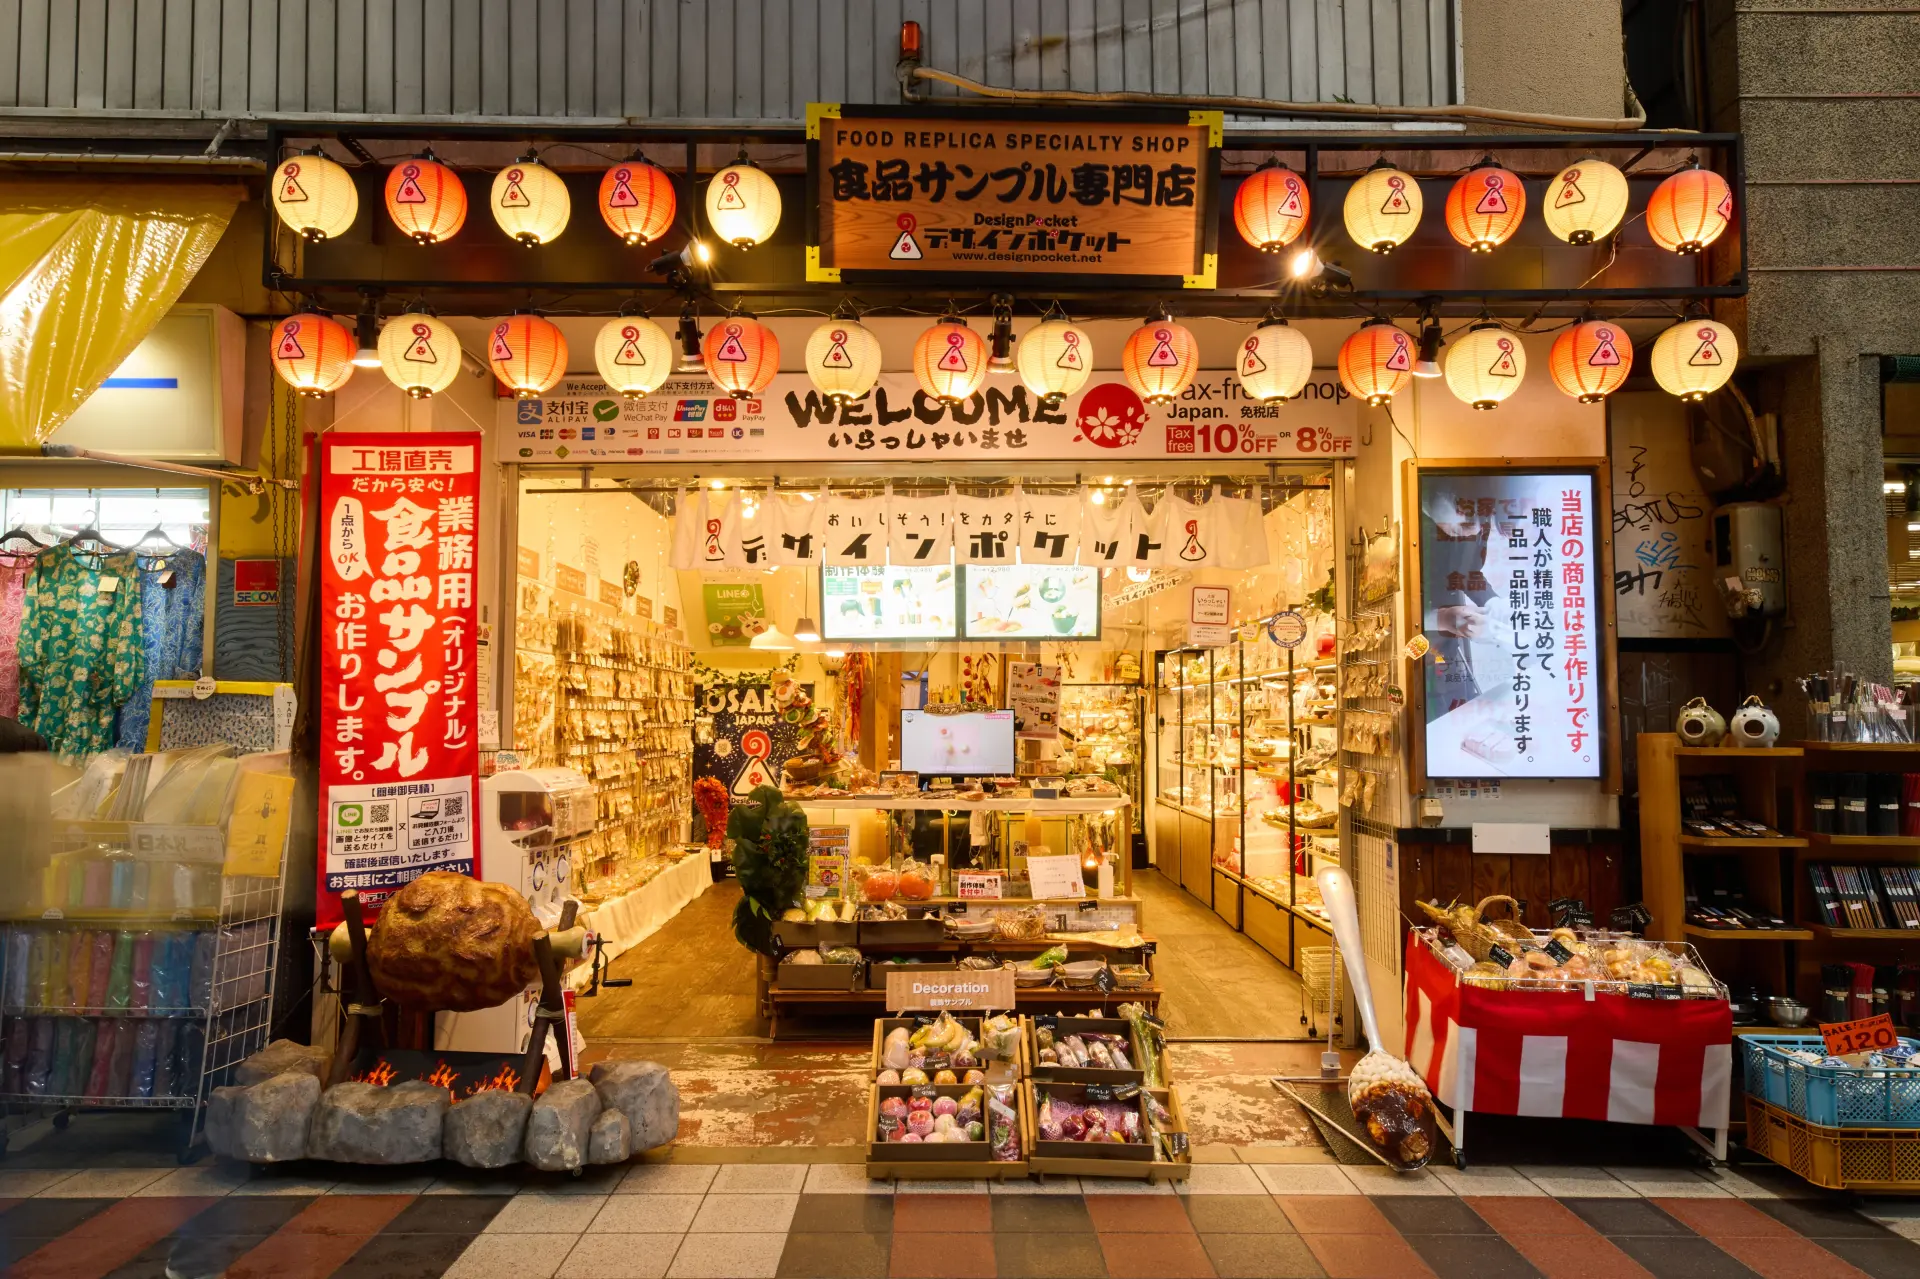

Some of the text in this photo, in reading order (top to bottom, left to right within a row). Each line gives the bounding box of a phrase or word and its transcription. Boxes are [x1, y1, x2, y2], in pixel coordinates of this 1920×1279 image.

[837, 130, 1190, 153] FOOD REPLICA SPECIALTY SHOP
[829, 157, 1197, 207] 食品サンプル専門店
[924, 228, 1131, 252] デザインポケット
[952, 251, 1102, 263] www.designpocket.net
[580, 383, 607, 391] Accept
[1294, 382, 1351, 405] hop
[546, 401, 589, 415] 支付宝
[623, 401, 668, 412] 微信支付
[715, 404, 735, 412] d払い
[784, 385, 1067, 428] WELCOME
[1167, 403, 1229, 421] Japan.
[1240, 406, 1279, 419] 免税店
[655, 414, 668, 422] Pay
[828, 428, 1028, 451] いらっしゃいませ
[1168, 427, 1191, 439] Tax
[1167, 439, 1193, 452] free
[1240, 439, 1278, 453] OFF
[1319, 440, 1352, 453] OFF
[351, 450, 453, 471] 工場直売
[352, 477, 455, 493] だから安心!
[742, 531, 1162, 563] デザインポケット
[1532, 507, 1557, 679] 職人が精魂込めて、
[1560, 489, 1591, 763] 当店の商品は手作りです。
[369, 496, 441, 777] 食品サンプル
[1507, 514, 1535, 763] 一品一品制作しております。
[335, 592, 367, 781] お作りします。
[706, 688, 780, 713] OSAK
[398, 822, 407, 831] 又
[424, 825, 455, 836] ご入力後
[336, 833, 393, 843] 画像とサイズを
[412, 833, 463, 847] 送信するだけ!
[344, 842, 384, 852] 送るだけ!
[344, 848, 456, 869] 確認後返信いたします。
[912, 982, 989, 995] Decoration
[1823, 1021, 1857, 1037] SALE!
